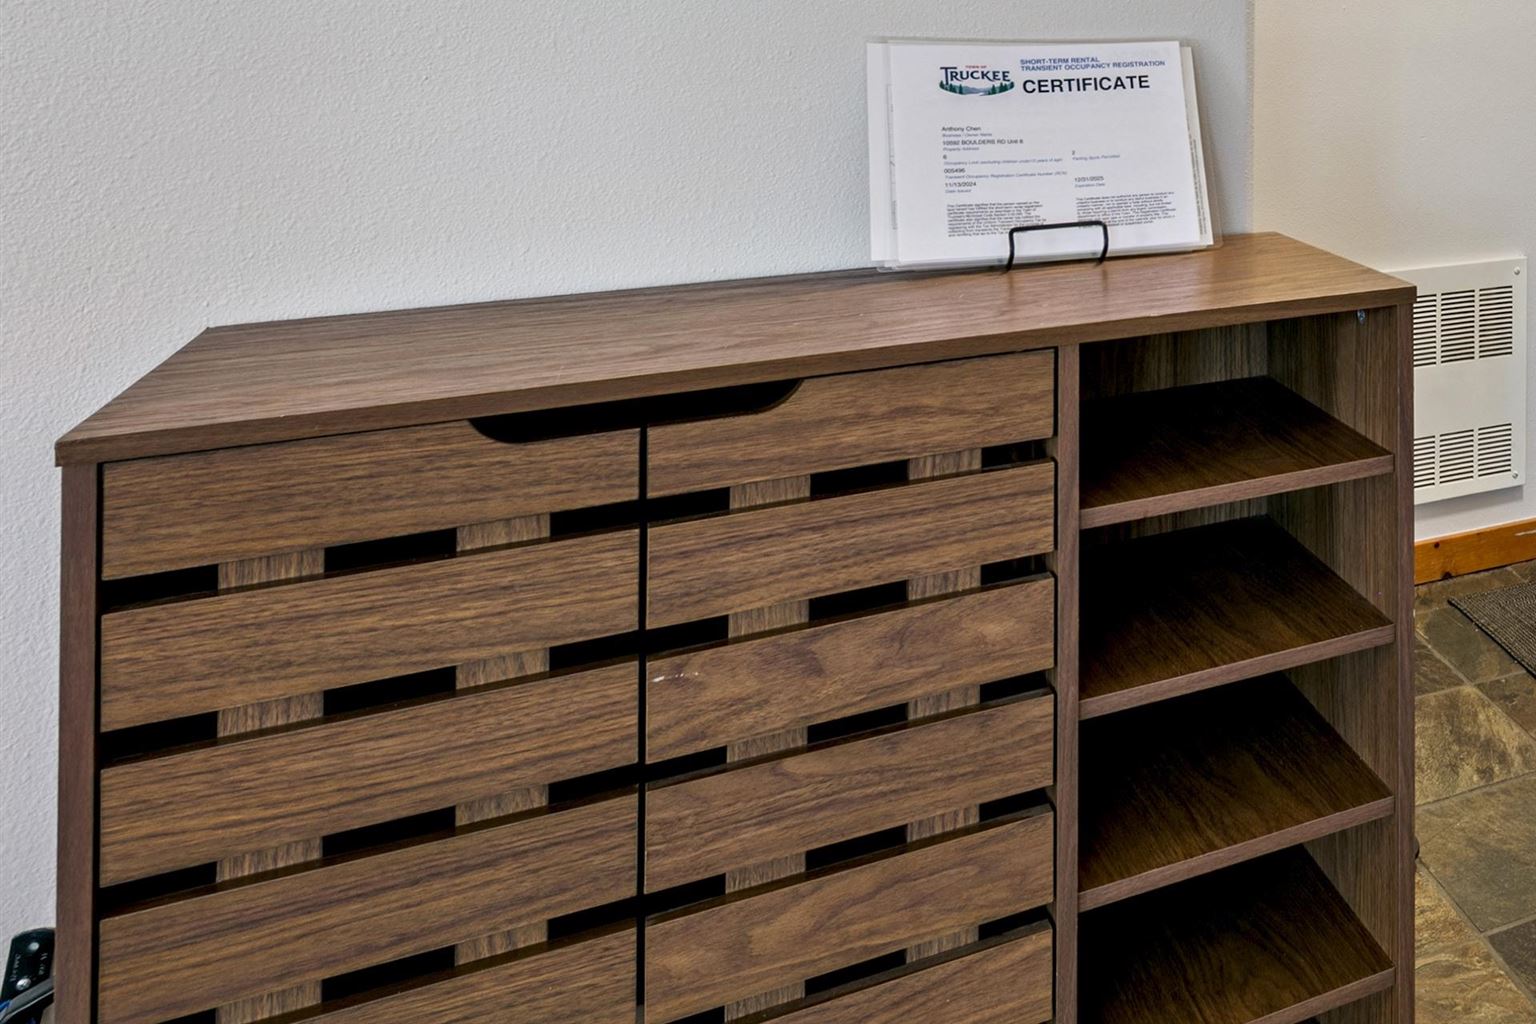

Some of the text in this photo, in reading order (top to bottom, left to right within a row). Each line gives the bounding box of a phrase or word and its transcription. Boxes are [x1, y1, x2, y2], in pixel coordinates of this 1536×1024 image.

[1064, 62, 1110, 70] OCCUPANCY
[1112, 60, 1166, 68] REGISTRATION
[939, 67, 1011, 85] TRUCKEE
[1023, 75, 1150, 93] CERTIFICATE
